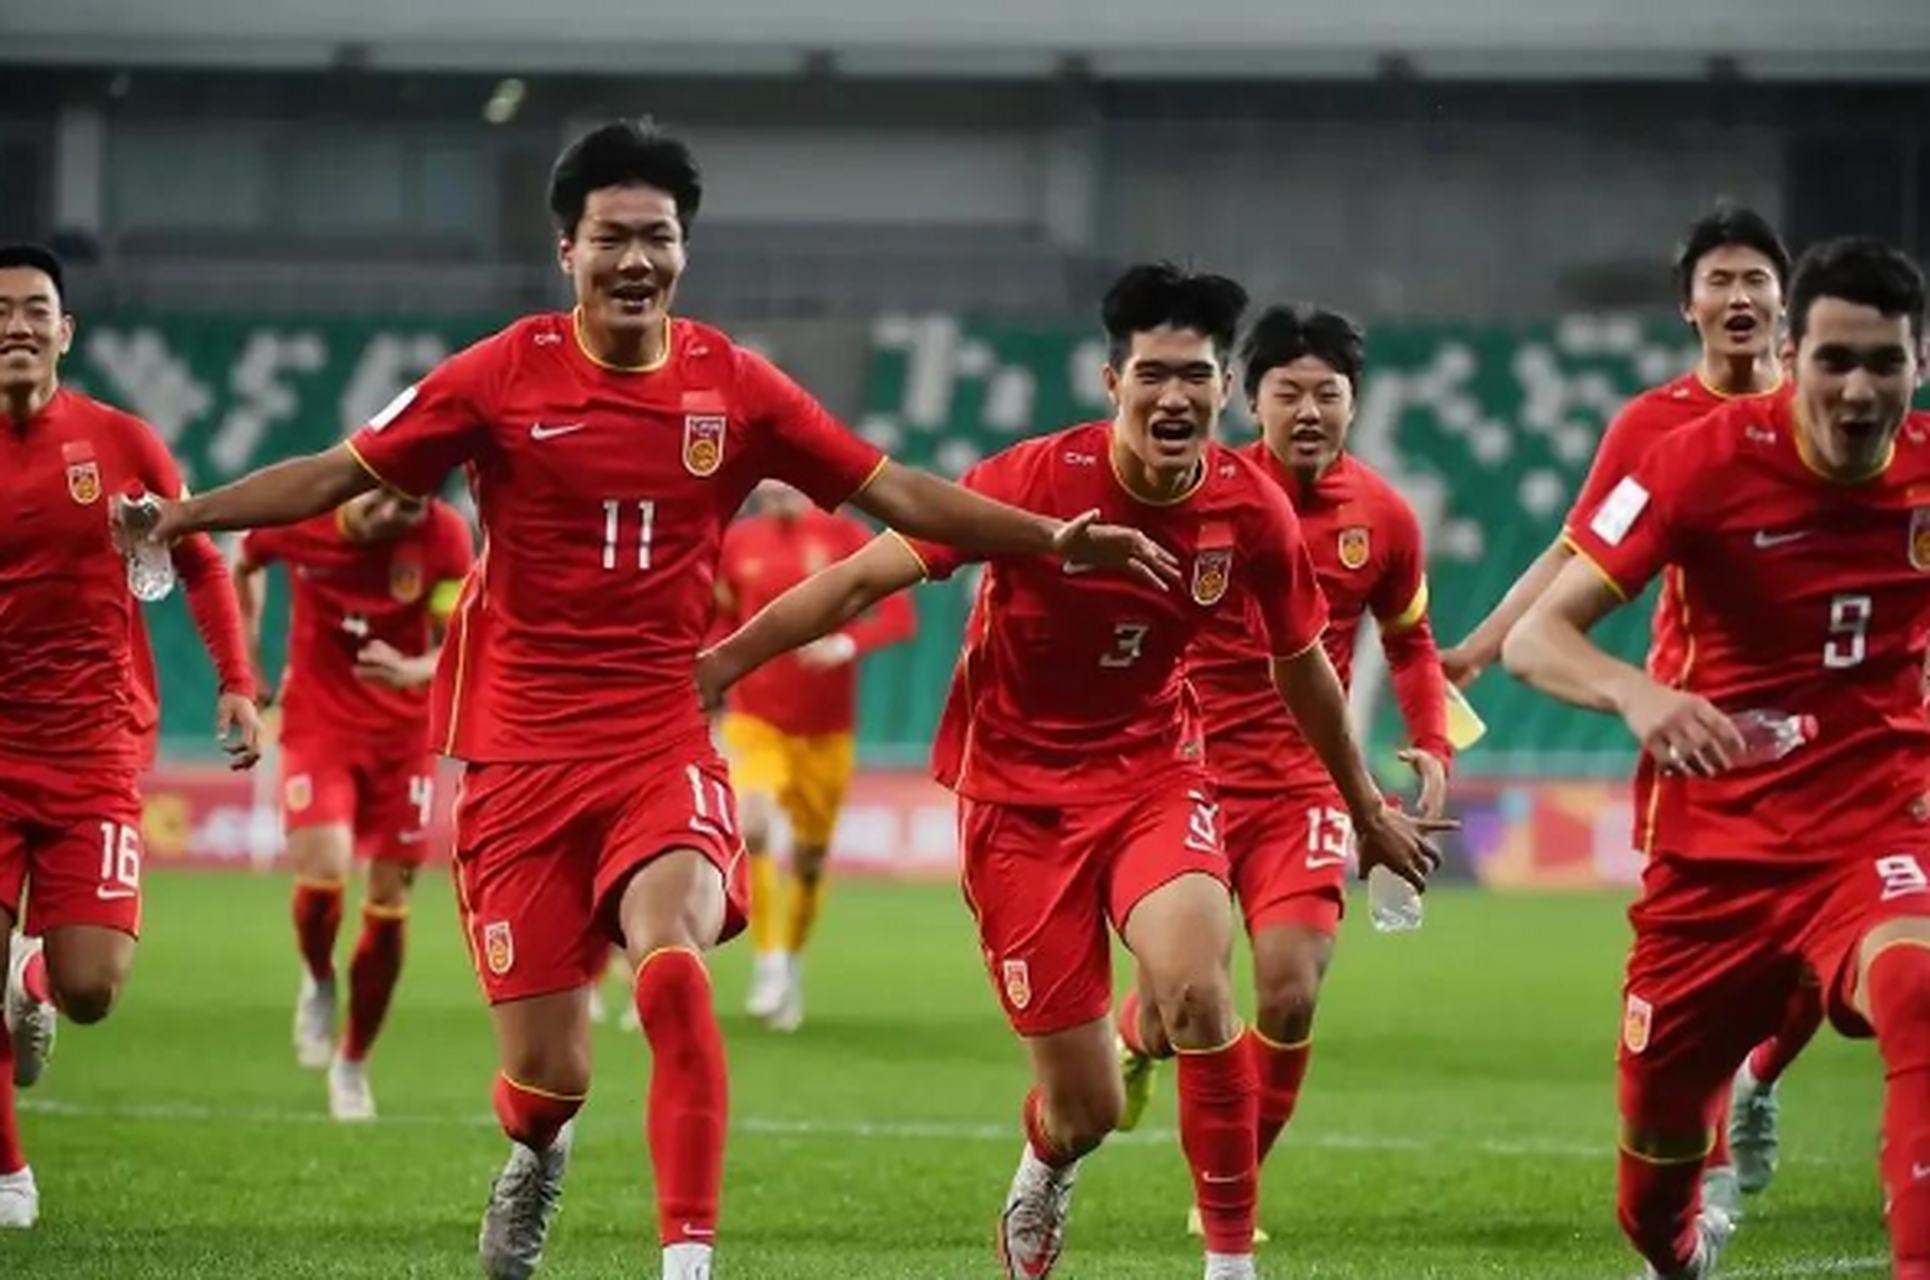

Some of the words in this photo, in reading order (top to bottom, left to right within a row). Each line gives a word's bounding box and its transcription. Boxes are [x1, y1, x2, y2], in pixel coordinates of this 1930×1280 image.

[602, 499, 655, 569] 11
[1099, 623, 1149, 668] 3
[1823, 595, 1871, 667] 9
[410, 775, 433, 827] 4
[685, 764, 732, 834] 11
[100, 822, 140, 888] 16
[1306, 806, 1351, 857] 13
[1874, 854, 1927, 886] 9
